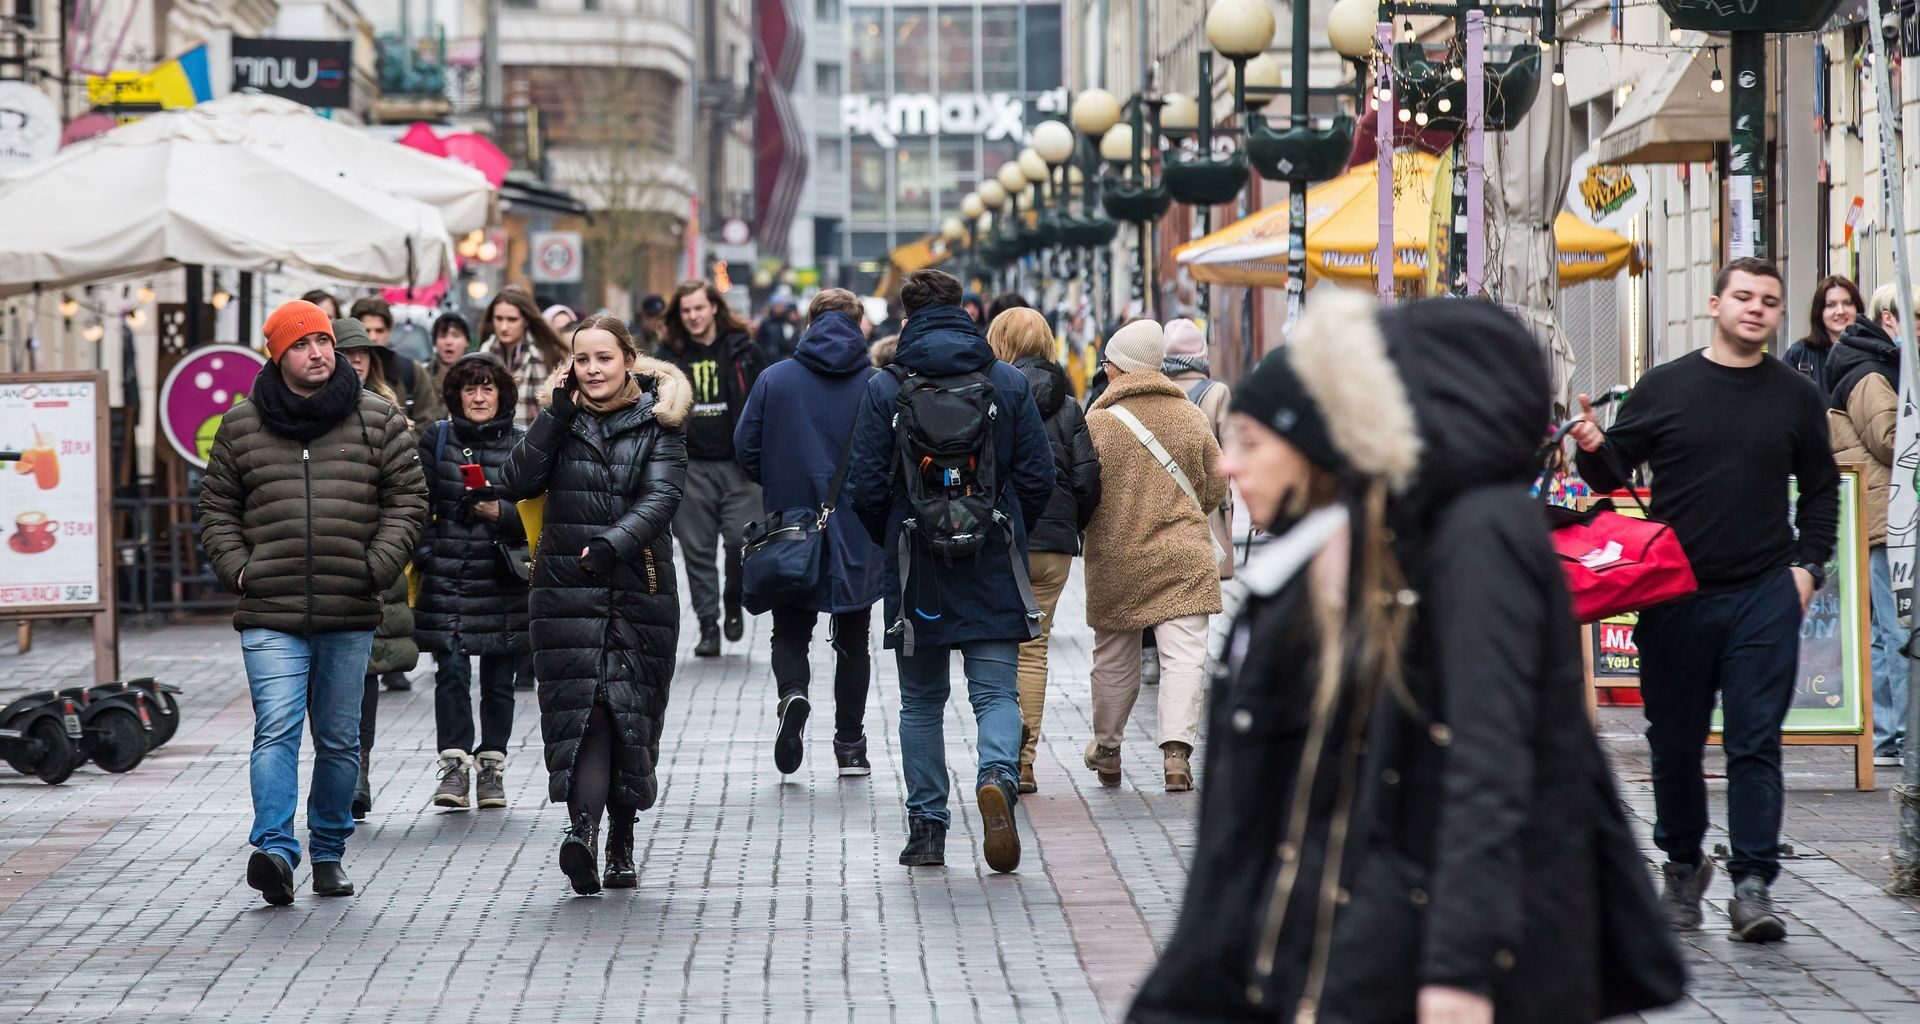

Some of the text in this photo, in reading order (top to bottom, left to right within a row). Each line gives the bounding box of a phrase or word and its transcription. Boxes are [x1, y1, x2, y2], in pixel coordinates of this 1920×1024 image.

[1322, 250, 1365, 269] Pizza
[1899, 597, 1912, 611] 19
[1606, 656, 1630, 669] YOU
